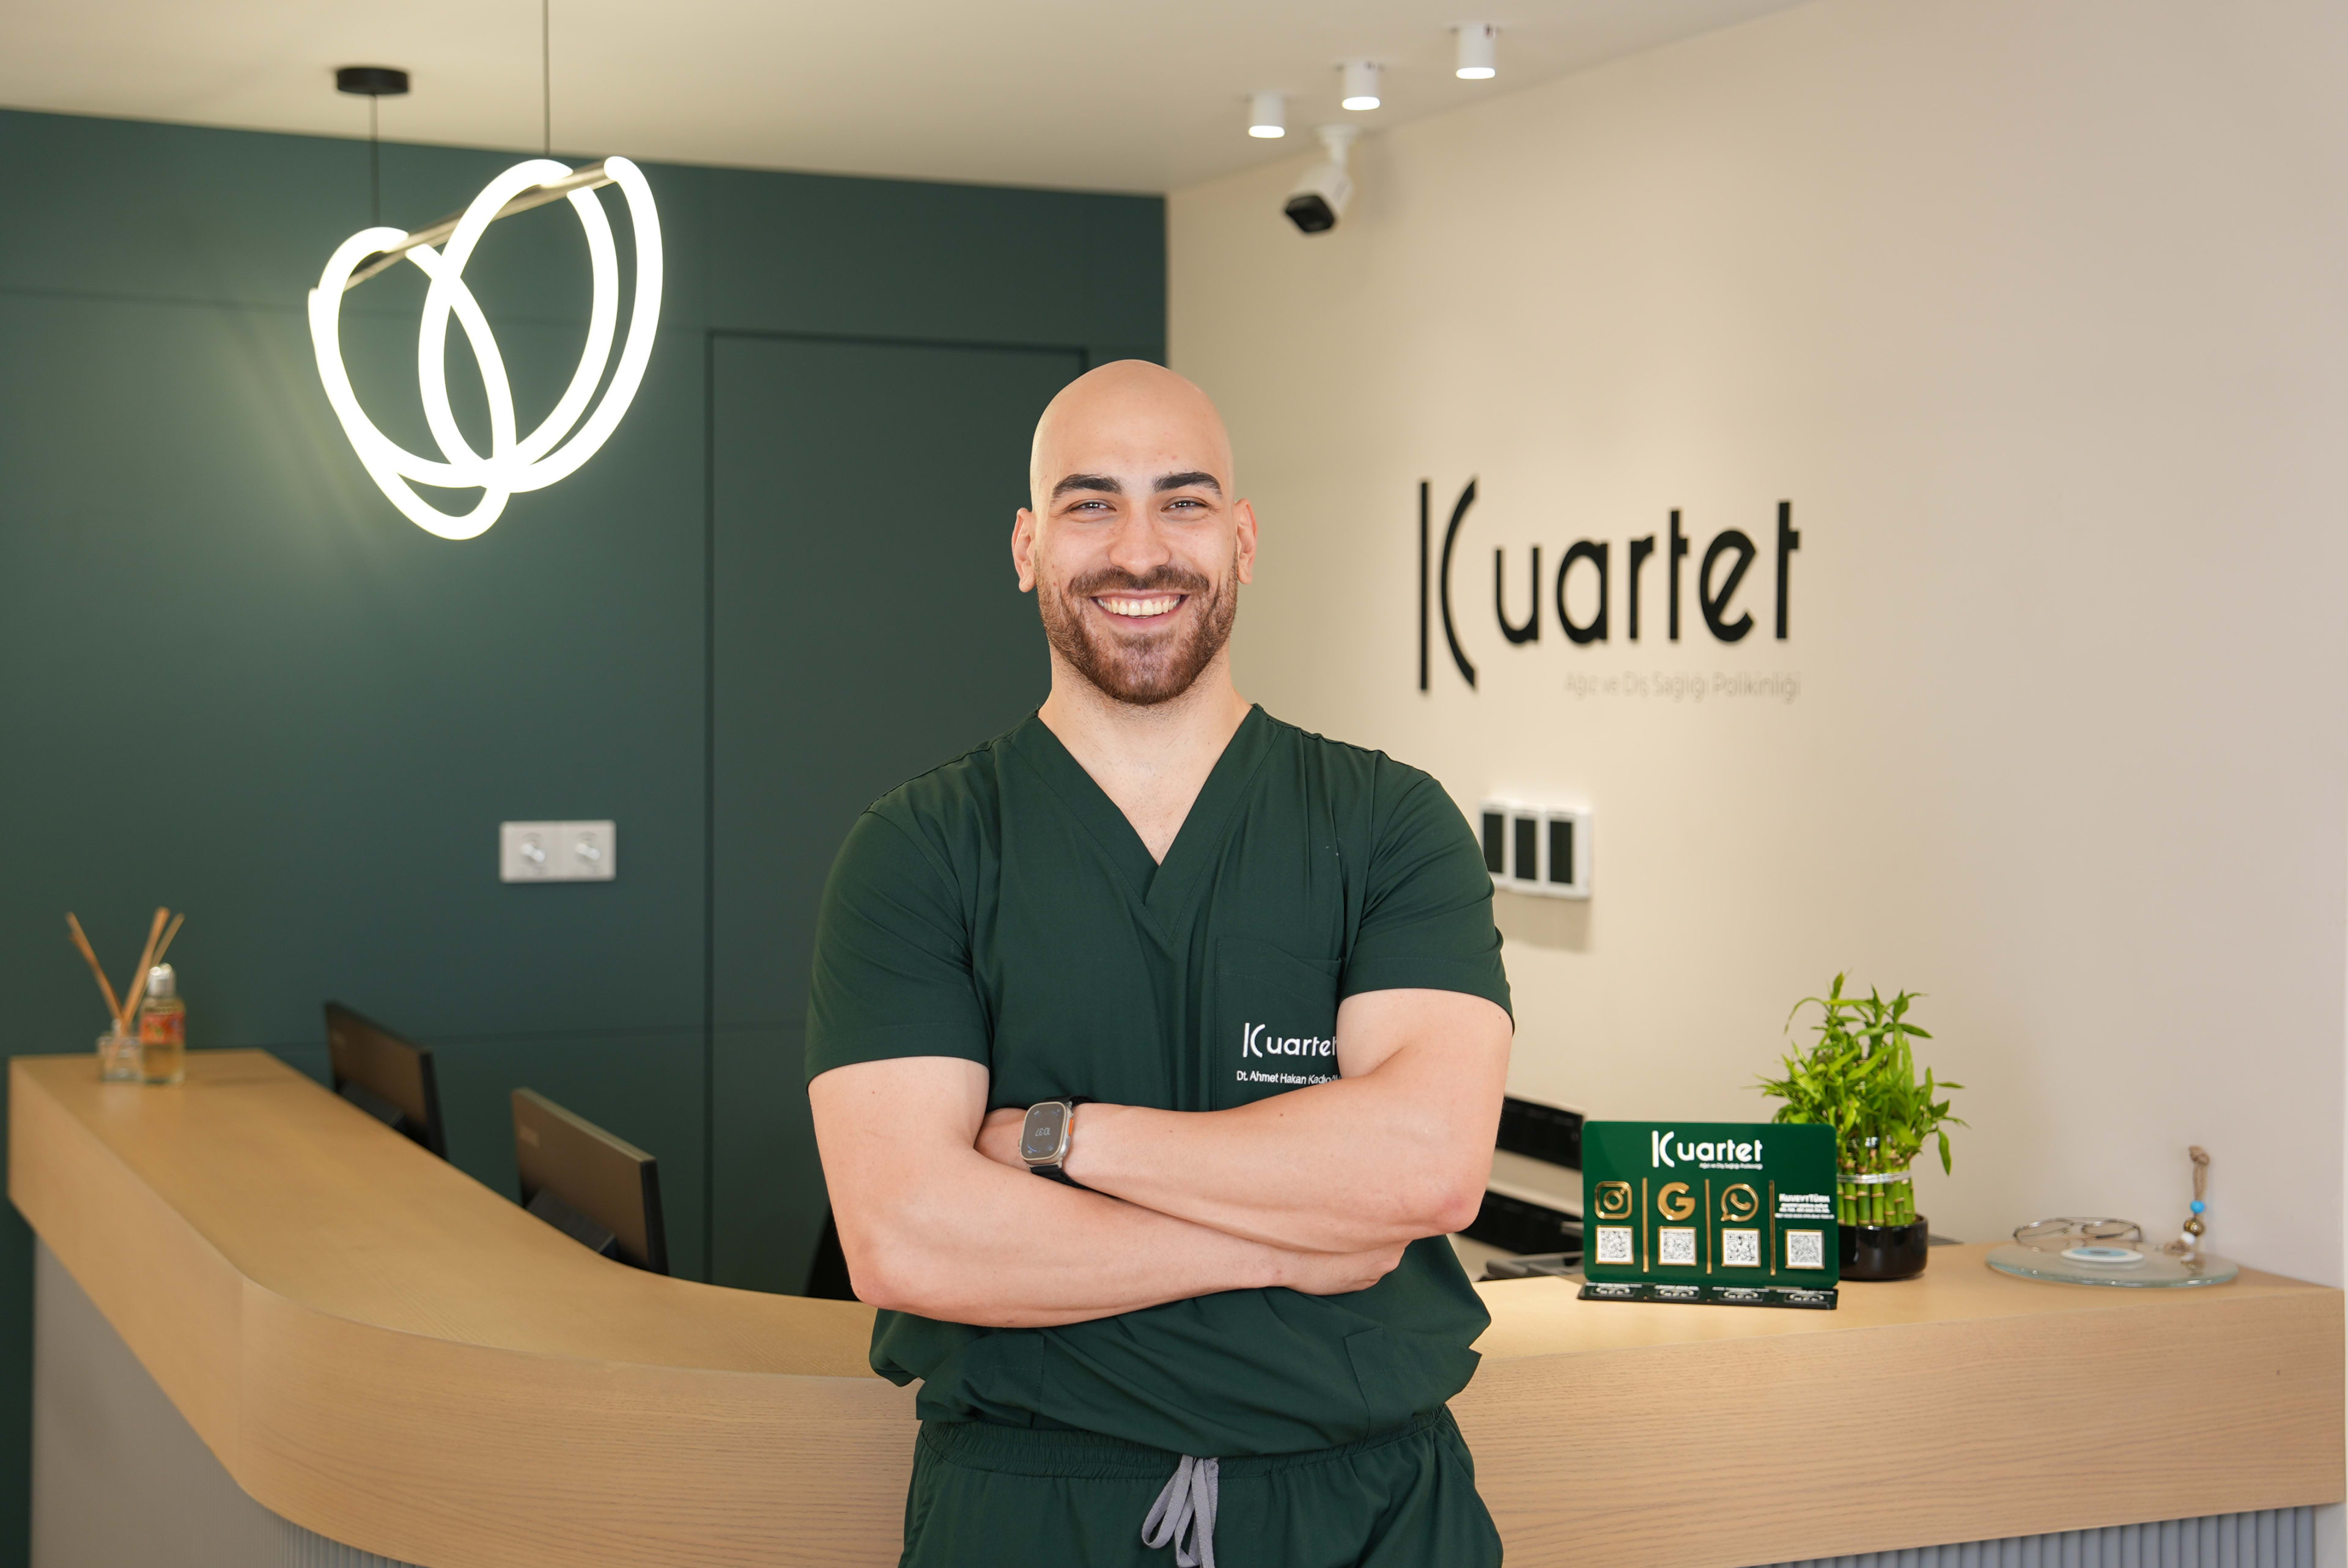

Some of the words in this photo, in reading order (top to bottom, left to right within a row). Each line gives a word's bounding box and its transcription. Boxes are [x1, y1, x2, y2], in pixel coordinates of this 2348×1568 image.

[1419, 477, 1800, 692] Kuartet
[1242, 1023, 1337, 1058] Kuartet
[1250, 1071, 1279, 1083] Ahmet
[1280, 1073, 1307, 1084] Hakan
[1652, 1130, 1763, 1168] Kuartet
